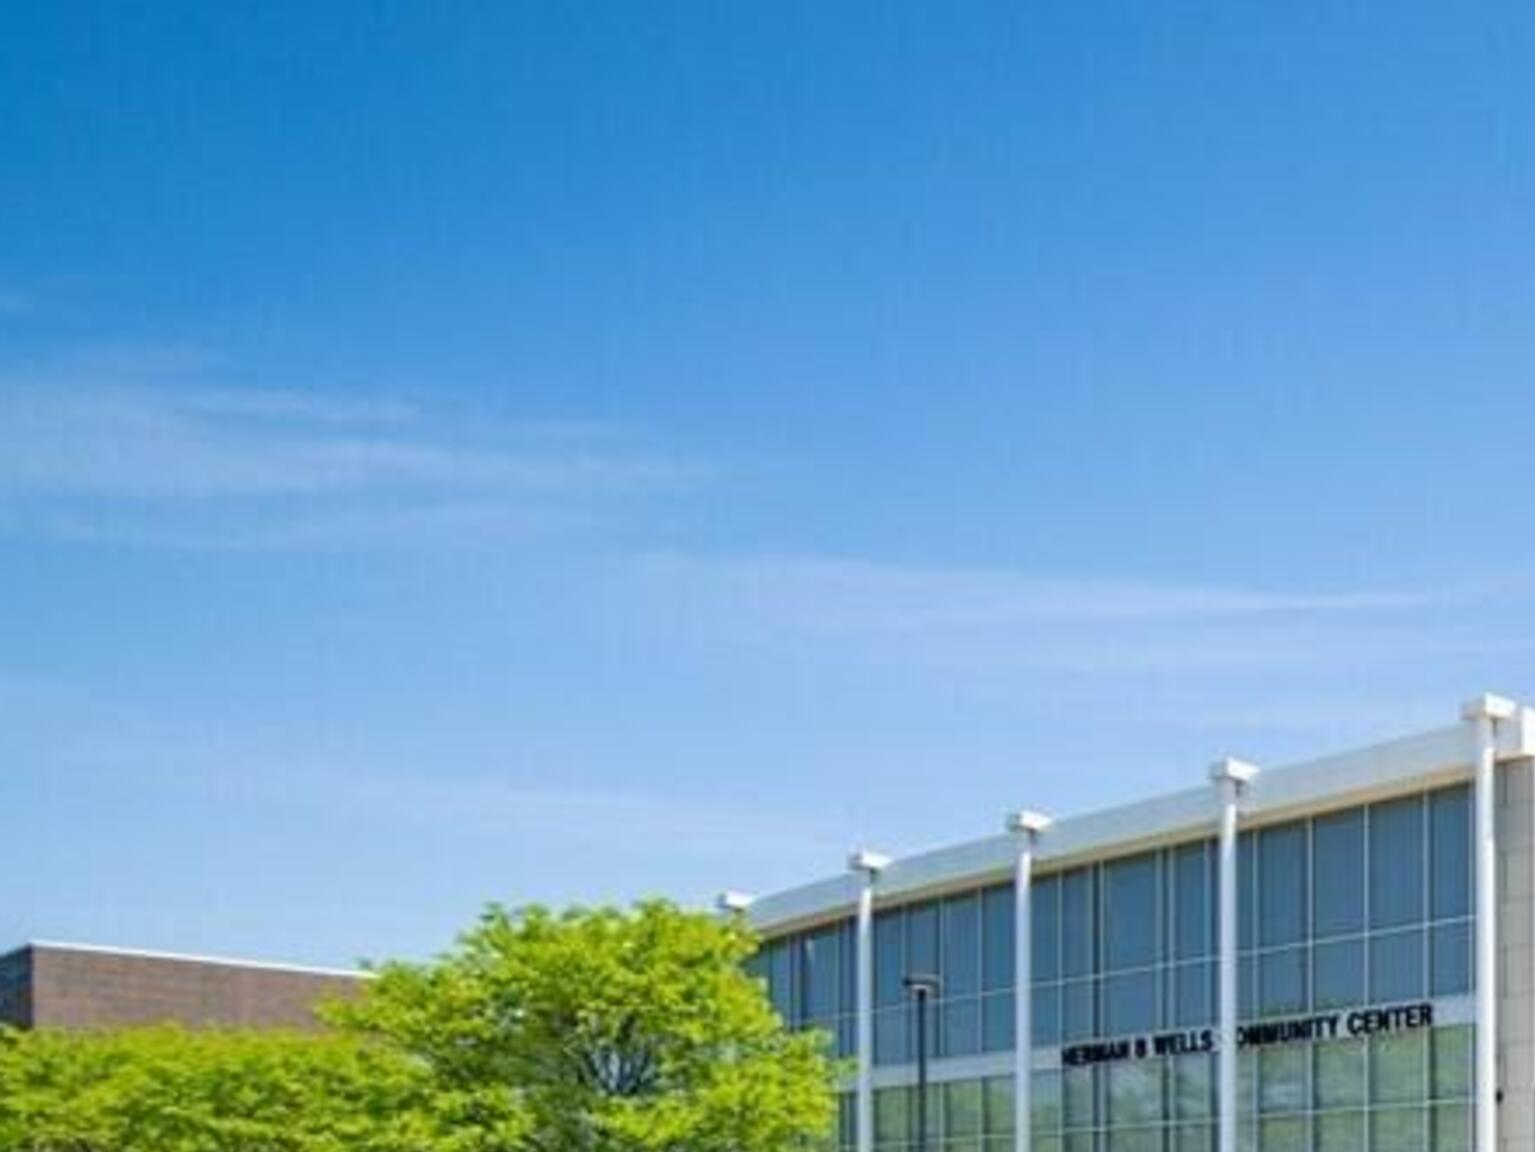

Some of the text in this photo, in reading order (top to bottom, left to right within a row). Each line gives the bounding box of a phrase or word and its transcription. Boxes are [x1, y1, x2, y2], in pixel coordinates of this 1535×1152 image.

[1154, 1029, 1214, 1055] WELLS
[1236, 1014, 1340, 1046] OMMUNITY
[1347, 1003, 1432, 1035] CENTER
